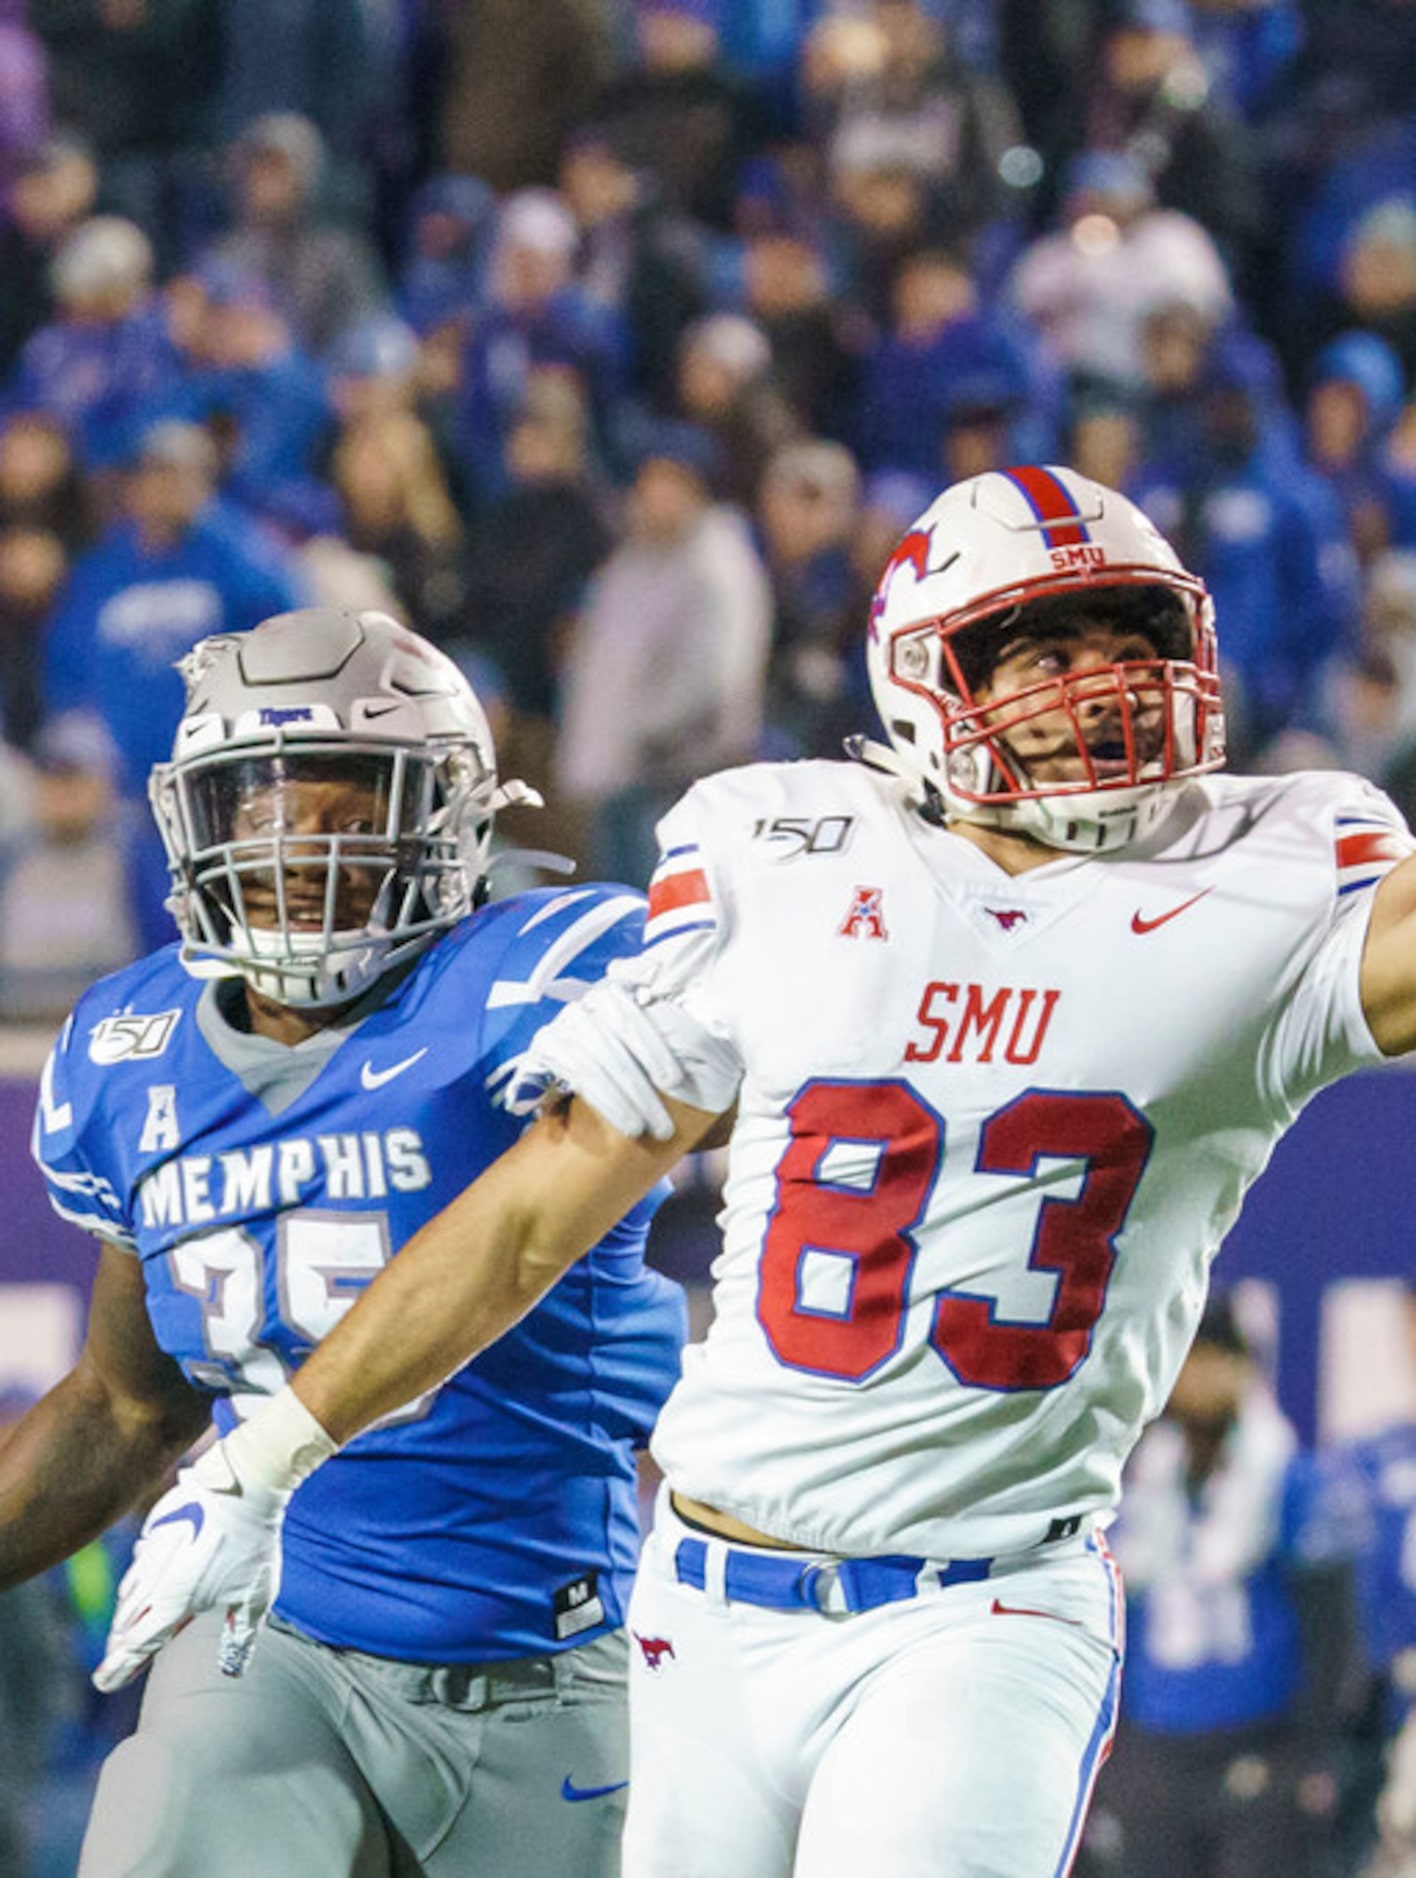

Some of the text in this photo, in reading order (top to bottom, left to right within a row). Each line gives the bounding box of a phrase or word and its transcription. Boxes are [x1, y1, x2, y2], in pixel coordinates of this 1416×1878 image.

[1050, 547, 1105, 571] SMU
[903, 981, 1061, 1065] SMU
[140, 1126, 432, 1228] MEMPHIS
[754, 1077, 1156, 1393] 83
